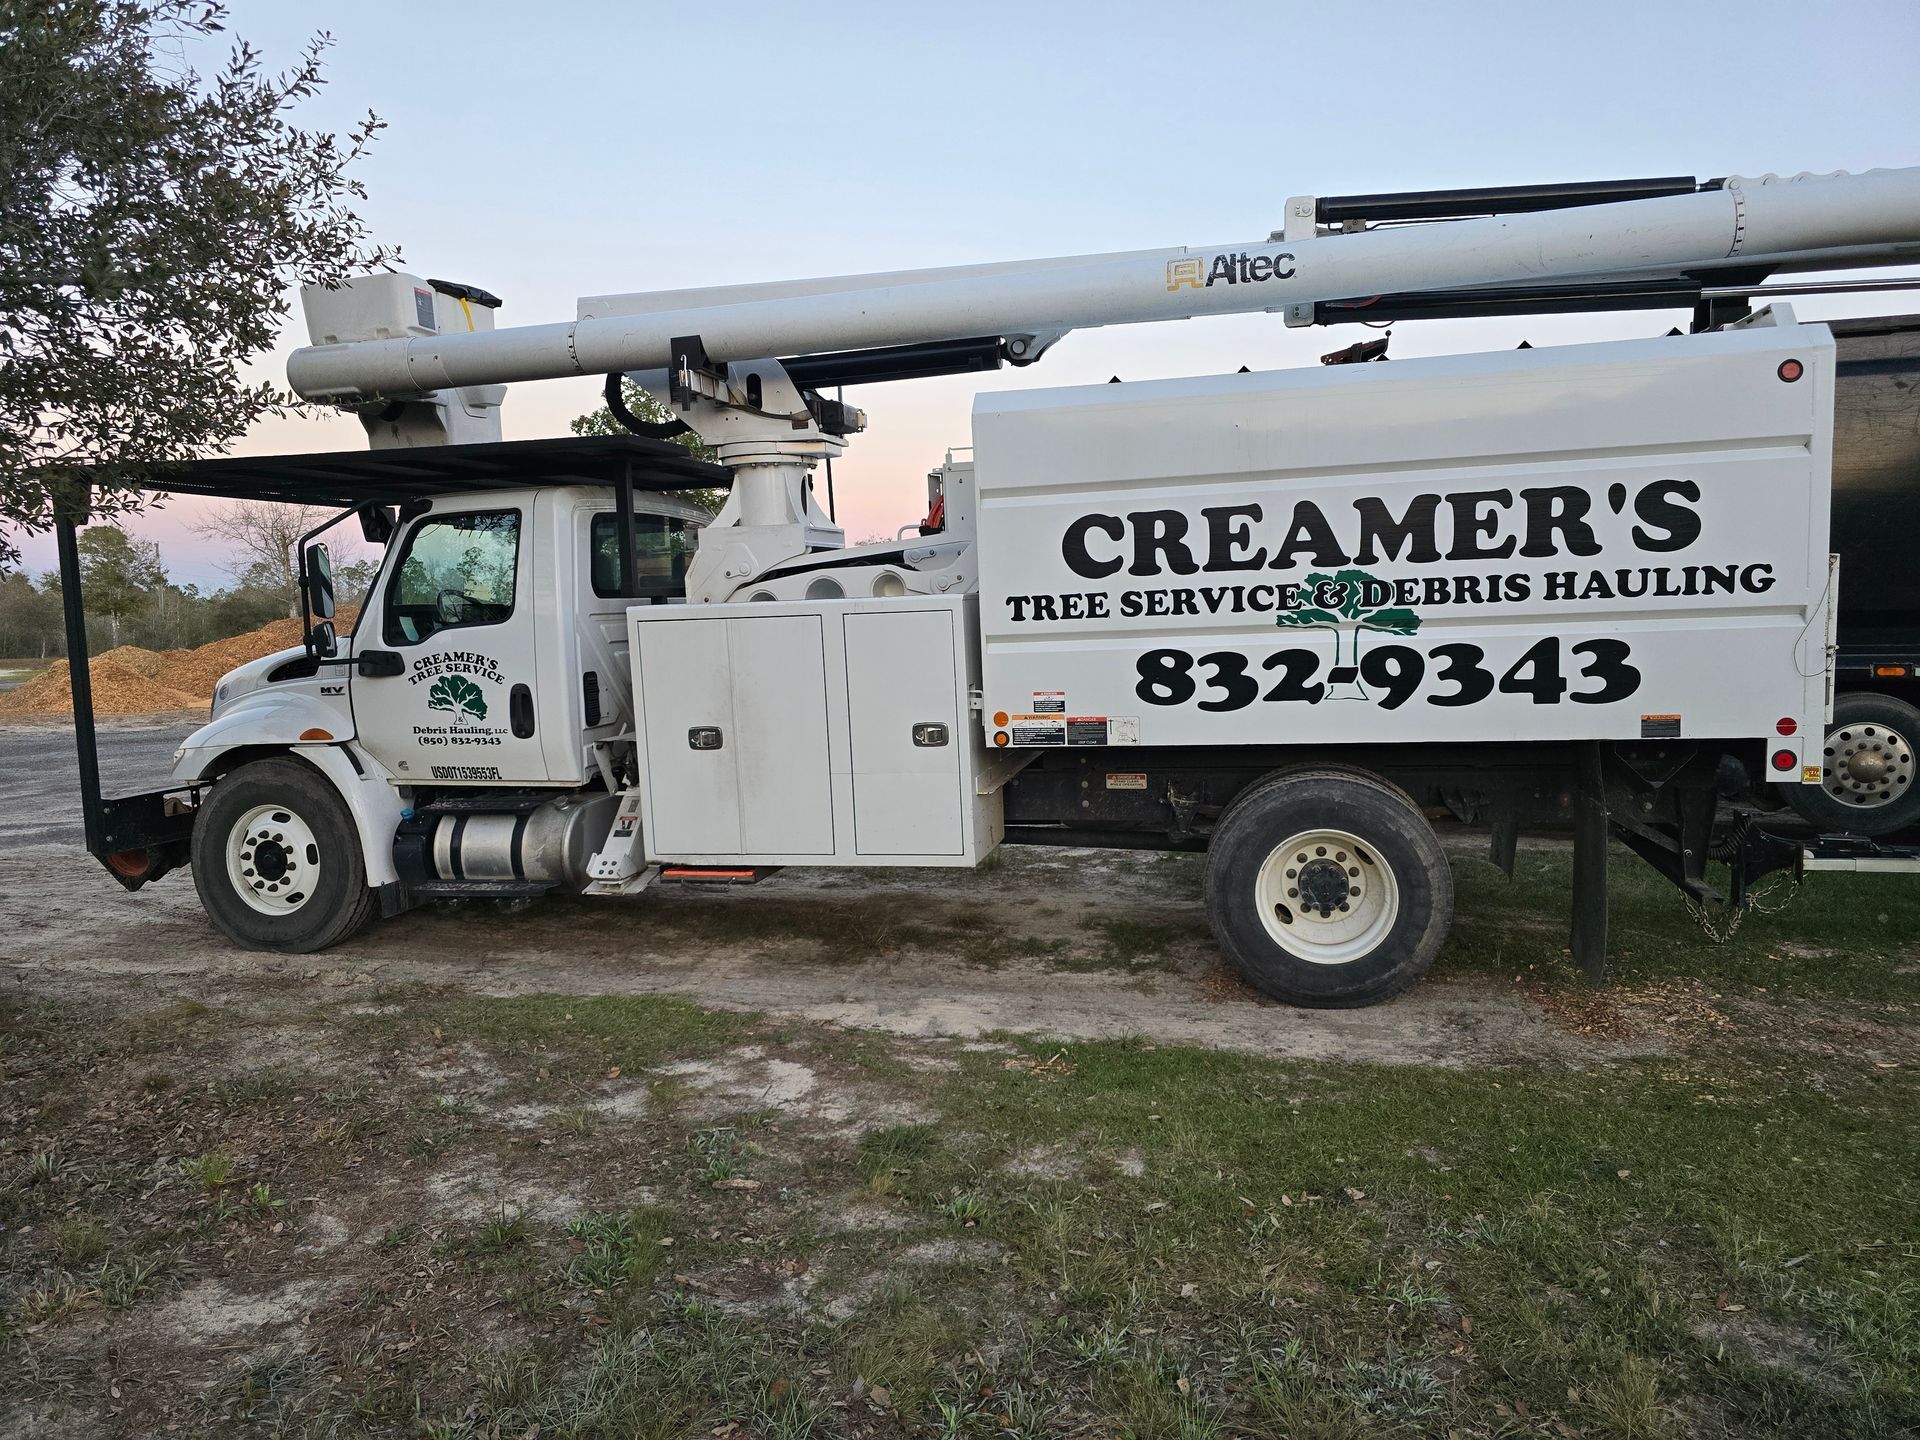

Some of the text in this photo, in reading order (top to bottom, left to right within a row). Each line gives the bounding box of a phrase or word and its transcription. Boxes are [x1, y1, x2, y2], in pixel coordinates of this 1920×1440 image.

[1205, 252, 1296, 287] Altec
[1062, 479, 1701, 579] CREAMER'S
[1006, 563, 1776, 622] TREE SERVICE & DEBRIS HAULING
[413, 651, 499, 671] CREAMER'S
[408, 663, 505, 685] TREE SERVICE
[1135, 636, 1641, 713] 832-9343
[413, 726, 447, 734] Debris
[418, 736, 501, 746] (850) 832-9343
[431, 766, 502, 780] USDOT1539553FL
